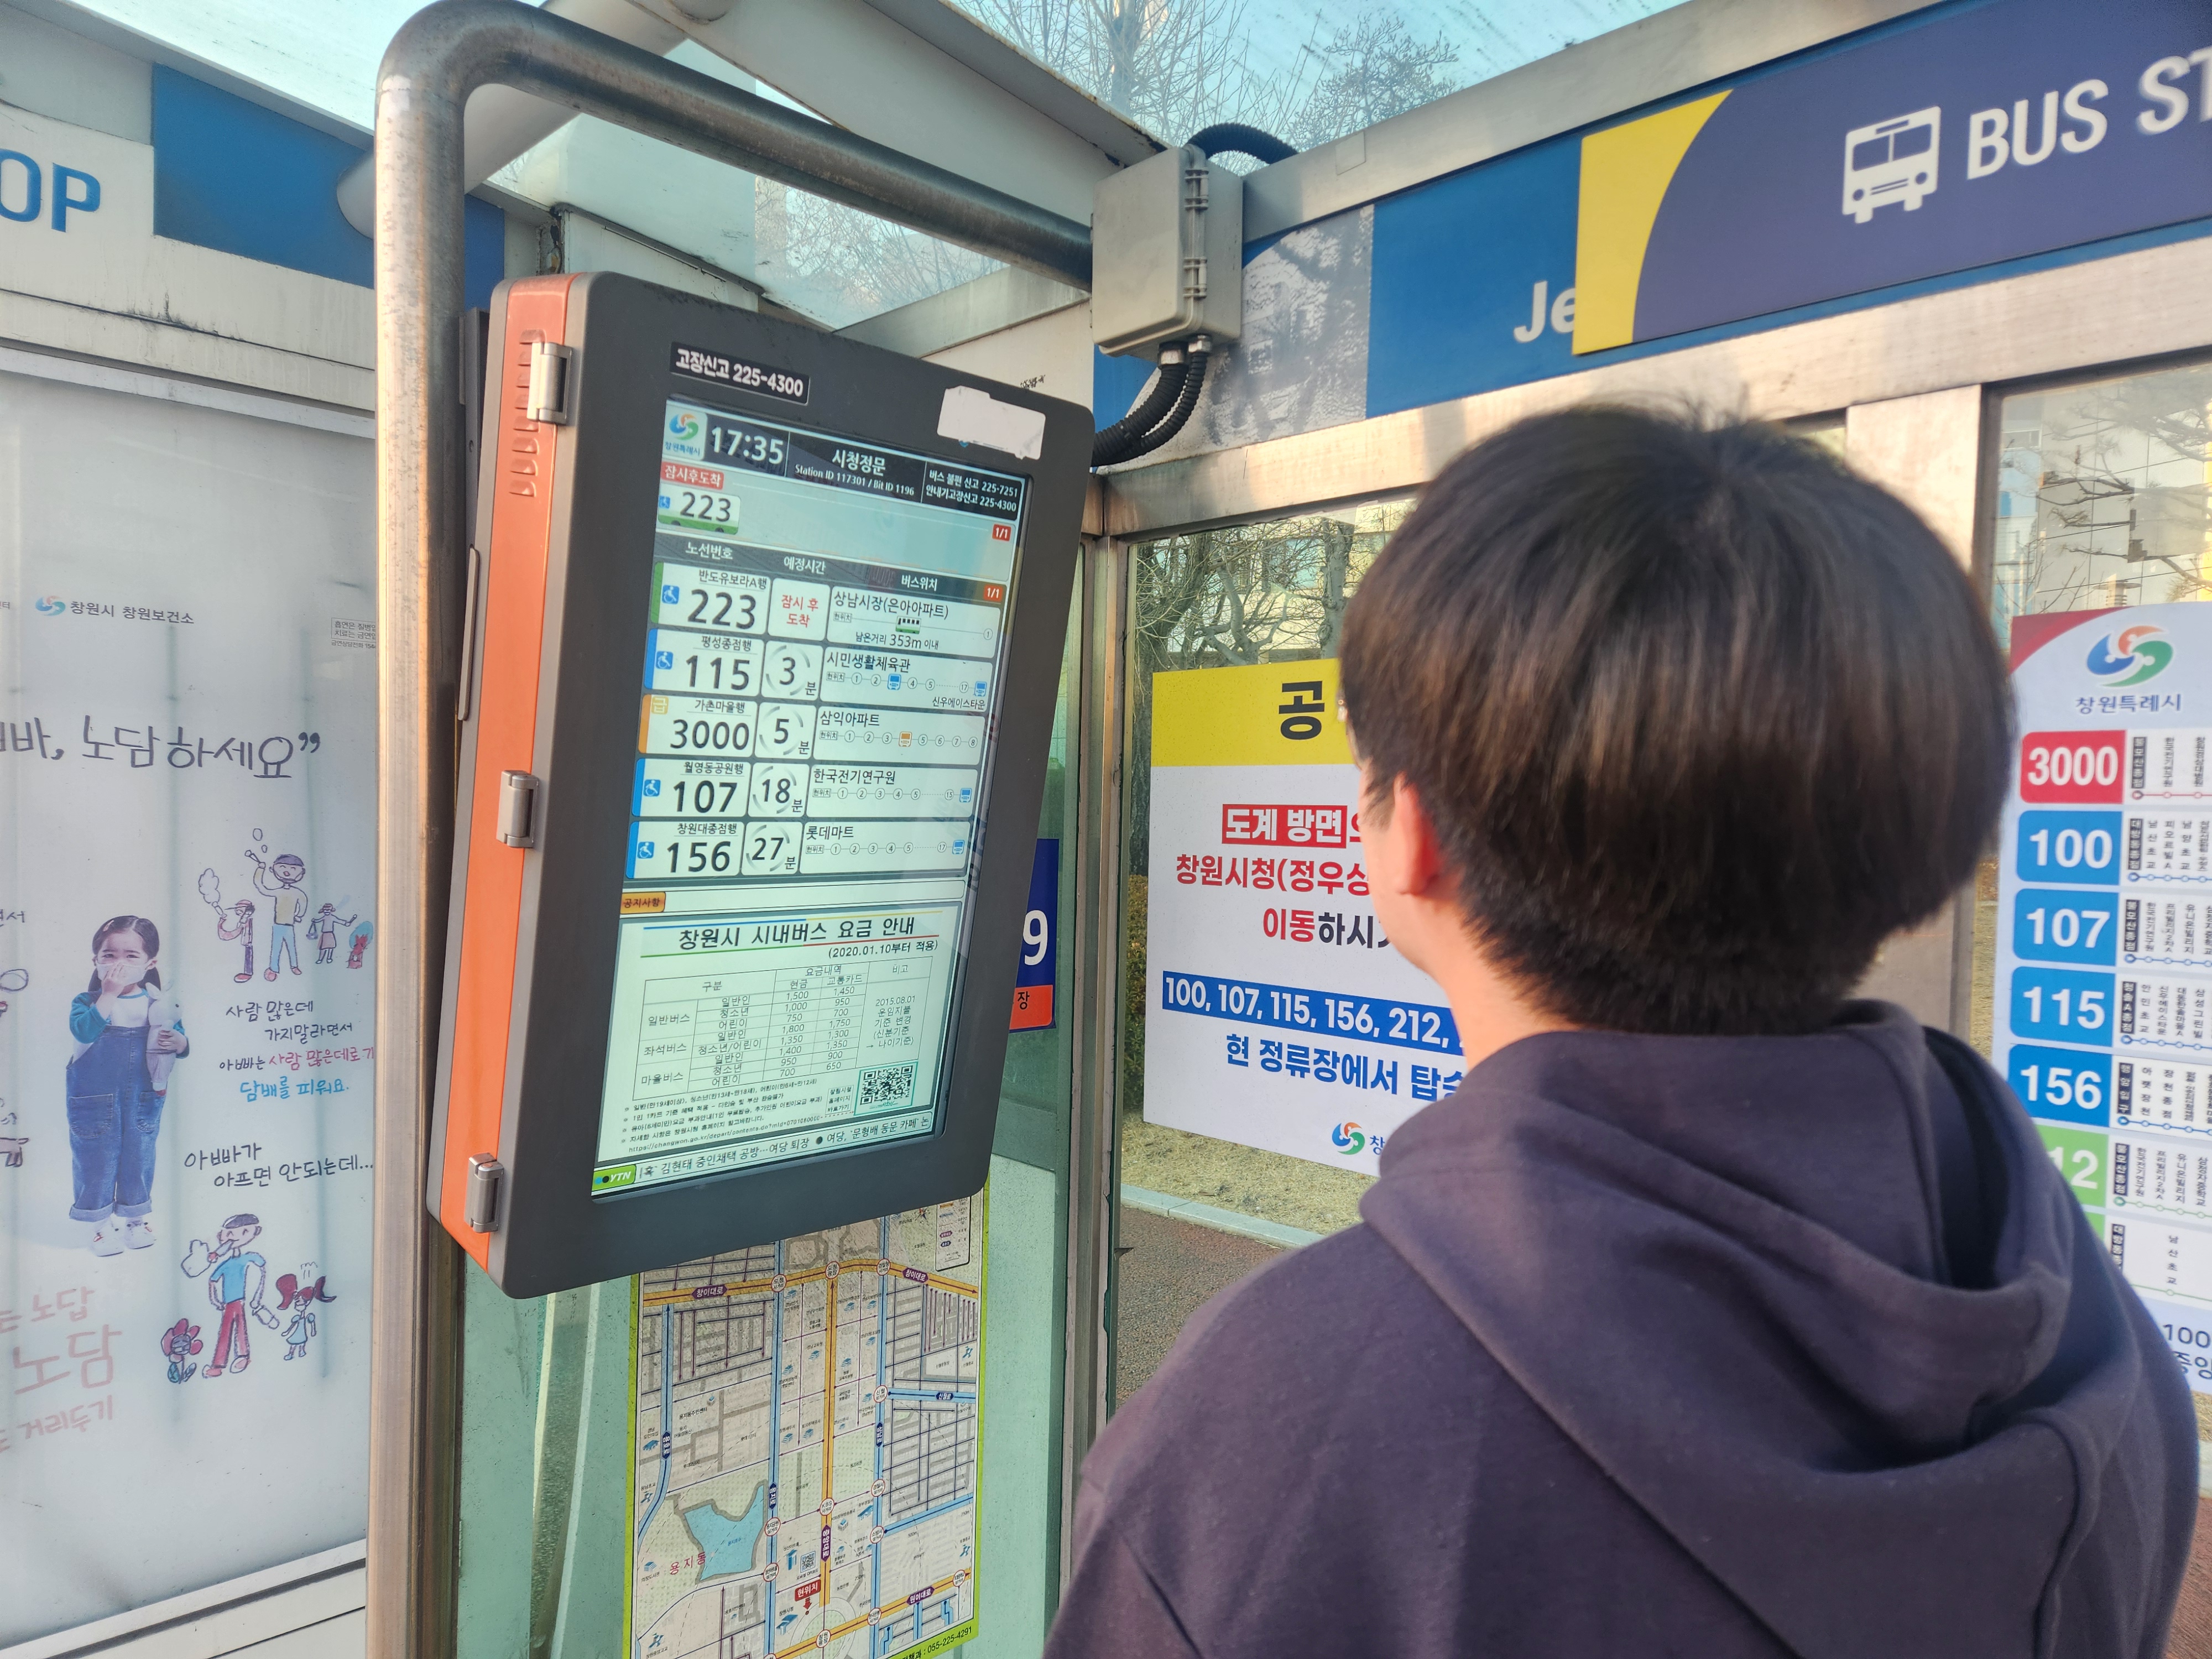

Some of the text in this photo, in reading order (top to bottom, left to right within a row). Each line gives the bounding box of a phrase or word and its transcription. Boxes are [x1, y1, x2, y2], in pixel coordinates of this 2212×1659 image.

[1966, 79, 2109, 180] BUS
[0, 148, 101, 232] OP
[675, 348, 804, 397] 고장신고 225-4300
[665, 442, 700, 456] 창원특례시
[711, 426, 784, 465] 17:35
[832, 448, 886, 476] 시청정문
[665, 465, 722, 488] 잠시후도착
[795, 464, 915, 496] Station ID 117301 Bit ID 1196
[929, 470, 945, 482] 버스
[963, 477, 979, 490] 신고
[981, 481, 1018, 498] 225-7251
[680, 491, 732, 522] 223
[926, 484, 1016, 512] 안내기고장신고 225-4300
[995, 527, 1008, 539] 1/1
[685, 541, 733, 560] 노선번호
[784, 556, 826, 575] 예정시간
[698, 569, 767, 589] 반도유보라A행
[901, 575, 1000, 599] 버스위치 1/1
[70, 601, 194, 625] 창원시 창원보건소
[687, 589, 757, 629] 223
[781, 594, 818, 612] 잠시 후
[834, 591, 949, 620] 상남시장(은아아파트)
[335, 621, 355, 630] 흡연은
[786, 613, 810, 628] 도착
[331, 640, 363, 648] 금연상담전화
[335, 630, 355, 638] 치료는
[701, 636, 752, 652] 평성종점행
[855, 632, 939, 650] 남은거리 353m 이내
[686, 655, 750, 691] 115
[827, 651, 911, 674] 시민생활체육관
[779, 656, 817, 696] 3 분
[695, 699, 745, 713] 가촌마을행
[932, 697, 985, 710] 신우에이스타운
[1278, 680, 1325, 740] 공
[2075, 693, 2182, 714] 창원특례시
[820, 711, 880, 728] 삼익아파트
[670, 719, 750, 750] 3000
[774, 718, 810, 755] 5 분
[684, 761, 744, 774] 월영동공원행
[813, 769, 896, 785] 한국전기연구원
[2028, 746, 2119, 786] 3000
[674, 780, 738, 813] 107
[761, 778, 803, 813] 18 분
[677, 823, 737, 835] 창원대종점행
[806, 826, 854, 841] 롯데마트
[1225, 808, 1277, 842] 도계
[667, 841, 732, 873] 156
[752, 837, 796, 870] 27 분
[2029, 828, 2113, 869] 100
[623, 898, 660, 909] 공지사항
[679, 917, 915, 950] 창원시 시내버스 요금 안내
[1262, 907, 1391, 949] 이동하시
[2026, 907, 2110, 948] 107
[828, 940, 938, 958] (2020.01.10부터 적용)
[702, 981, 722, 992] 구분
[805, 964, 842, 977] 요금내역
[790, 974, 863, 989] 현금 교통카드
[226, 1000, 313, 1022] 사람 많은데
[648, 986, 855, 1026] 일반버스 일반인 1,500 1,450
[720, 998, 850, 1019] 청소년 1,000 950
[875, 995, 916, 1007] 2015.08.01
[1165, 977, 1449, 1048] 100, 107, 115, 156, 212,
[2023, 986, 2105, 1029] 115
[719, 1008, 848, 1031] 어린이 750 700
[782, 1019, 851, 1034] 1,800 1,750
[220, 1056, 265, 1071] 아빠는
[269, 1052, 302, 1071] 사람
[644, 1042, 687, 1057] 좌석버스
[1227, 1033, 1249, 1067] 현
[1259, 1039, 1398, 1095] 정류장에서
[240, 1076, 290, 1102] 담배를
[641, 1072, 684, 1086] 마을버스
[2021, 1065, 2102, 1109] 156
[184, 1142, 262, 1167] 아빠가
[609, 1121, 898, 1182] YTN 김현태 증인채택 퇴장 동문
[214, 1165, 272, 1187] 아프면
[696, 1270, 926, 1299] 창이대로 창이대로
[13, 1324, 122, 1395] 노담
[17, 1394, 113, 1439] 거리두기
[797, 1583, 818, 1598] 현위치
[910, 1589, 931, 1604] 원이대로
[927, 1626, 972, 1653] 055-225-4291
